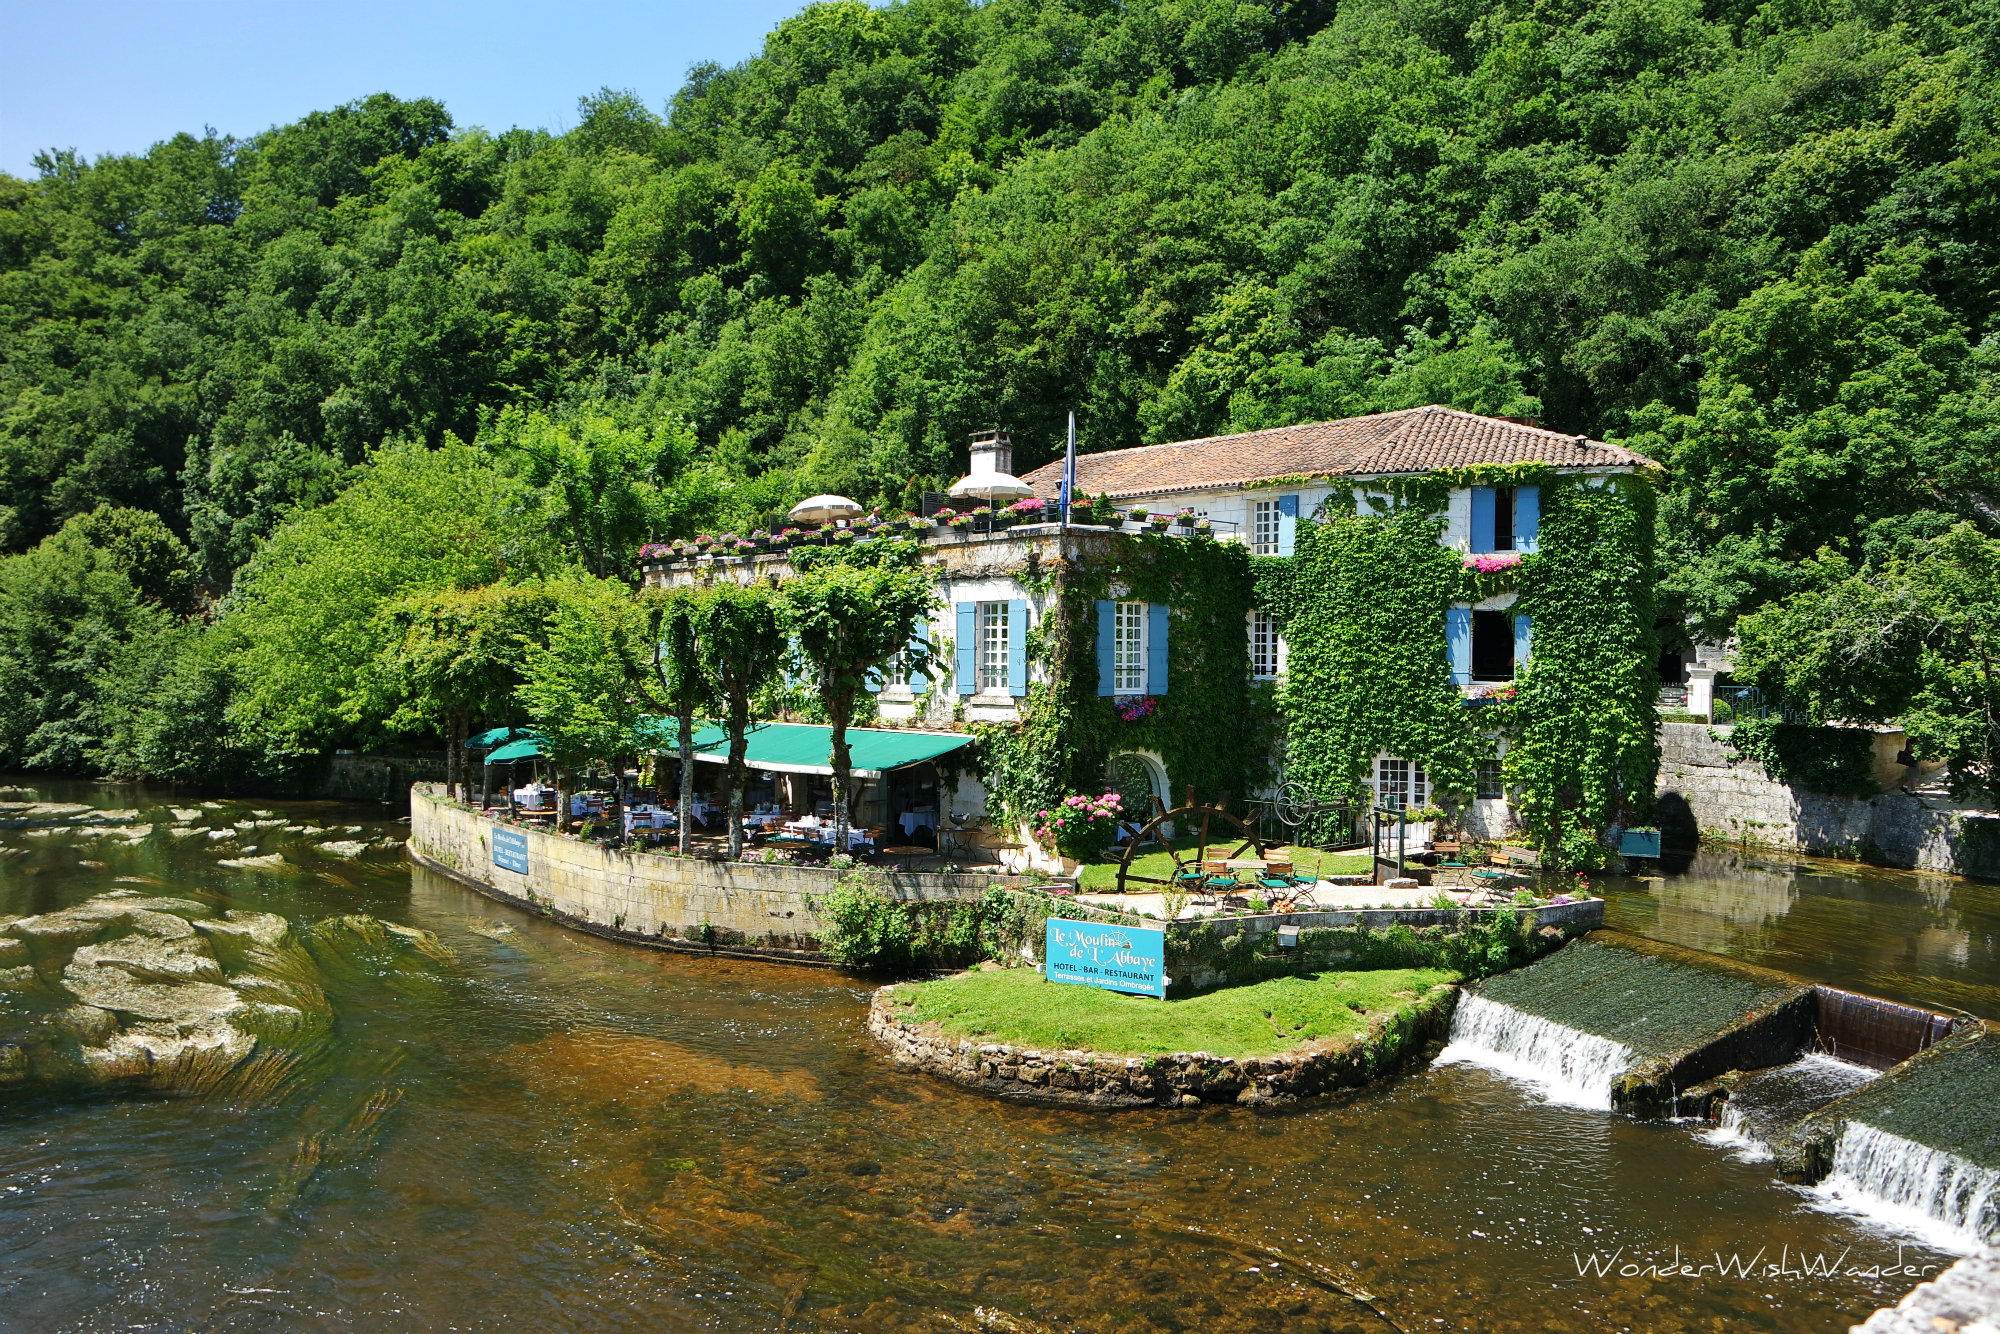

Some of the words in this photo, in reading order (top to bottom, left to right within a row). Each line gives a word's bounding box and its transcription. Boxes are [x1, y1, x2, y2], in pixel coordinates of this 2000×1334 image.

[1049, 927, 1068, 947] Le
[1069, 930, 1117, 949] Moulin
[1069, 945, 1084, 958] de
[1053, 963, 1077, 972] HOTEL
[1083, 966, 1099, 975] BAR
[1104, 969, 1155, 981] RESTAURANT
[1054, 971, 1085, 982] Terrasses
[1094, 977, 1118, 986] Jardins
